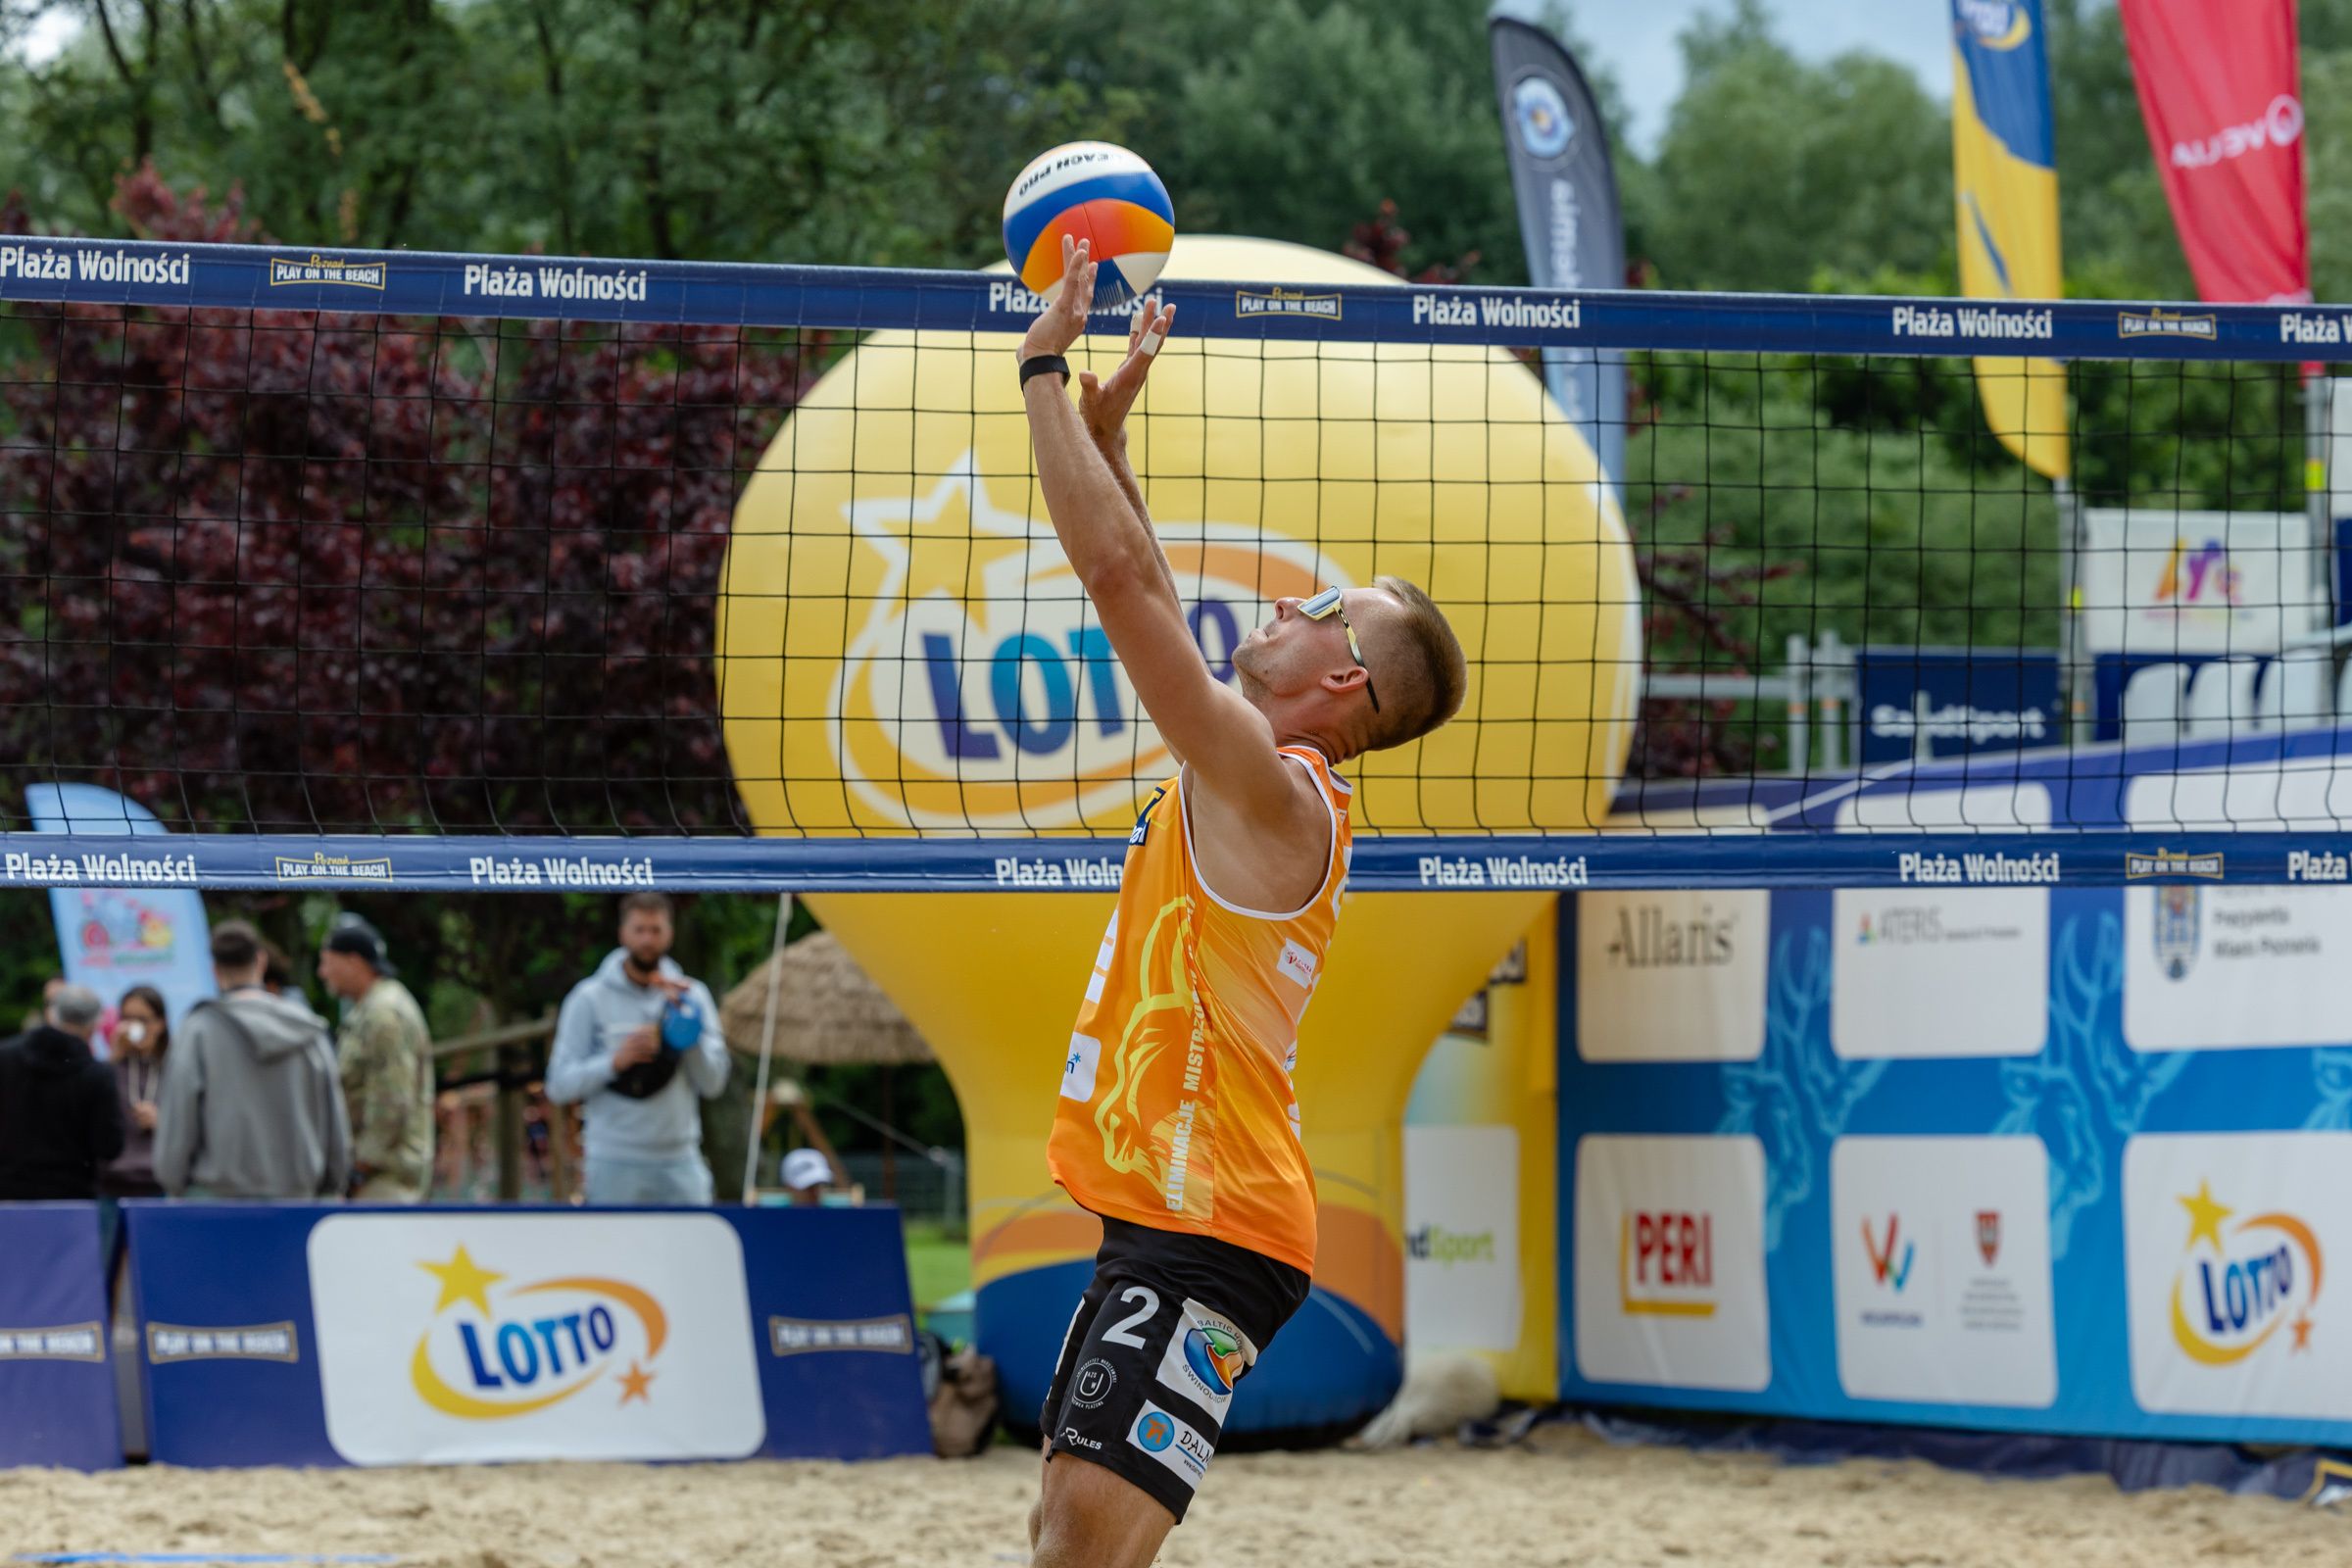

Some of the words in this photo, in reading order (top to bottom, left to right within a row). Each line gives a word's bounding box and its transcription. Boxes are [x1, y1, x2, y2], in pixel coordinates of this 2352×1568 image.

[1056, 152, 1109, 171] EACH
[0, 246, 71, 280] Plaża
[77, 249, 190, 284] Wolności
[276, 265, 302, 280] PLAY
[305, 267, 320, 279] ON
[323, 269, 342, 280] THE
[345, 269, 379, 284] BEACH
[465, 264, 533, 297] Plaża
[539, 267, 647, 301] Wolności
[1413, 294, 1477, 326] Plaża
[1481, 295, 1580, 328] Wolności
[1892, 306, 1954, 336] Plaża
[1957, 307, 2052, 338] Wolności
[2280, 313, 2340, 343] Plaża
[919, 596, 1240, 761] LOTO
[6, 852, 79, 881] Plaża
[81, 853, 197, 882] Wolności
[282, 862, 309, 877] PLAY
[311, 864, 326, 875] ON
[329, 864, 349, 876] THE
[352, 863, 386, 877] BEACH
[469, 856, 541, 885] Plaża
[543, 857, 655, 886] Wolności
[995, 857, 1063, 887] Plaża
[1064, 857, 1123, 887] Woln
[1419, 856, 1485, 886] Plaża
[1486, 856, 1589, 886] Wolności
[1899, 852, 1962, 883] Plaża
[1963, 852, 2061, 883] Wolności
[2287, 851, 2348, 880] Plaża
[1166, 1099, 1196, 1211] ELIMINACJE
[1183, 980, 1205, 1093] MISTRZO
[1638, 1212, 1712, 1287] PERI
[2199, 1244, 2293, 1334] LOTTO
[1102, 1286, 1160, 1349] 2
[1197, 1319, 1233, 1334] BALTIC
[459, 1304, 614, 1387] LOTTO
[1065, 1426, 1102, 1450] RULES
